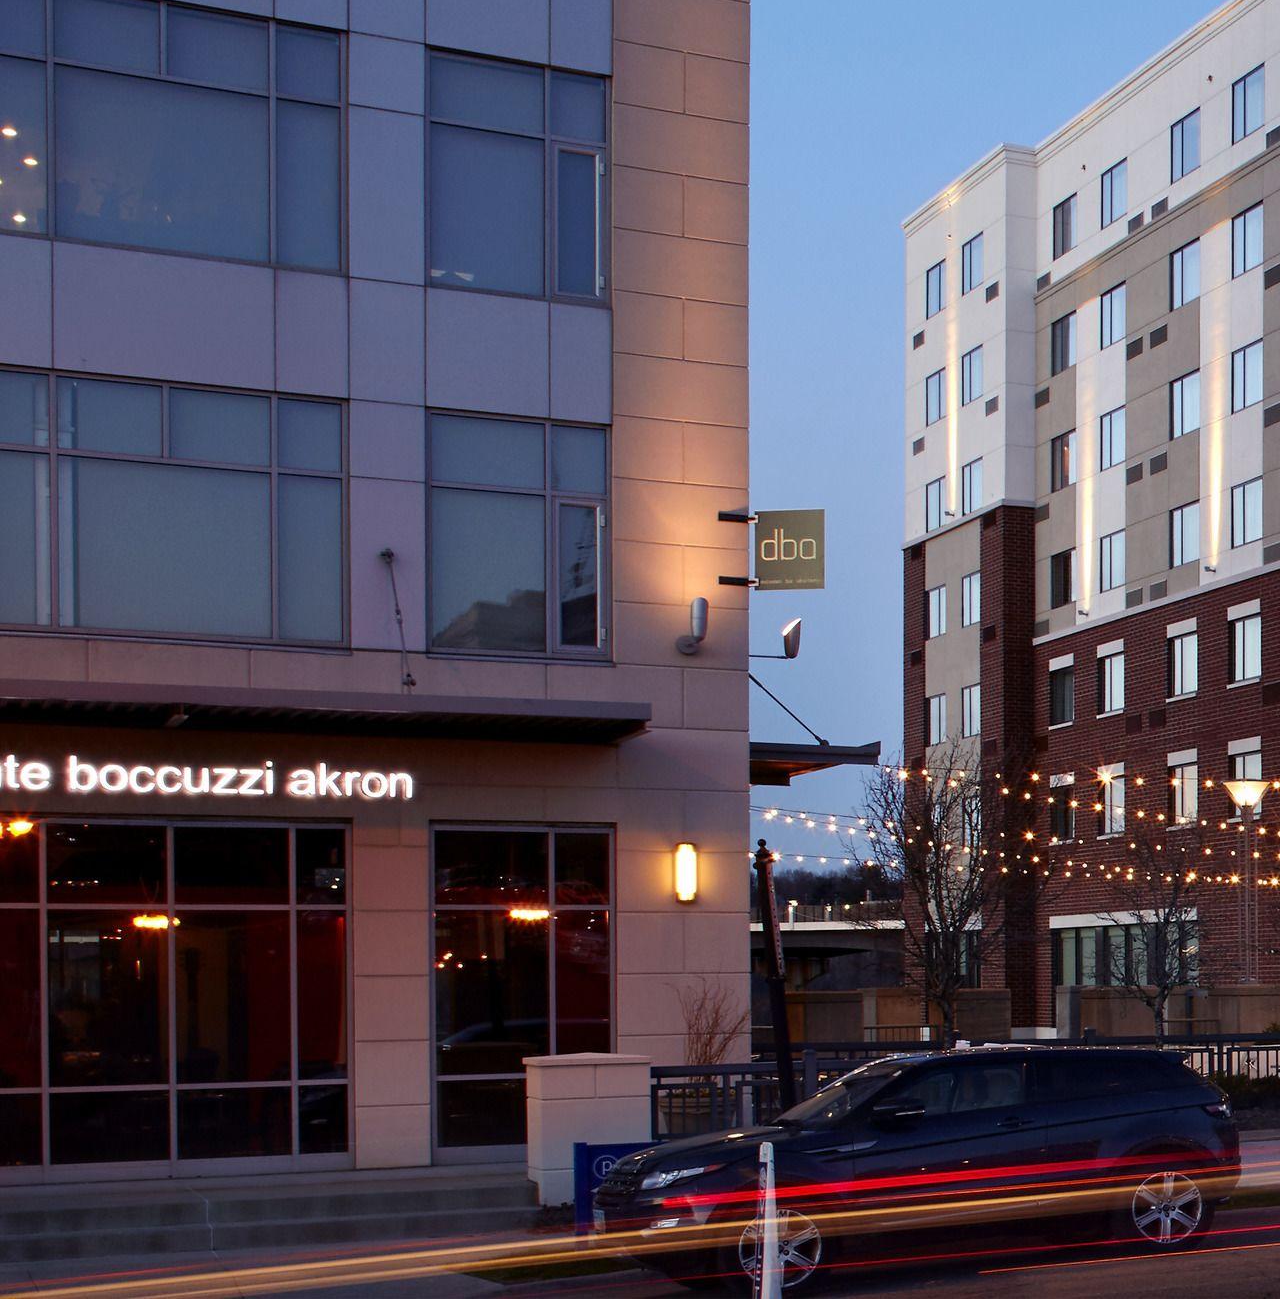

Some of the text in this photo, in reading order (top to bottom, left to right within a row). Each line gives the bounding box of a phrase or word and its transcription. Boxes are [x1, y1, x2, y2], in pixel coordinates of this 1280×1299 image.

[761, 528, 816, 561] dba
[0, 754, 413, 799] te boccuzzi akron
